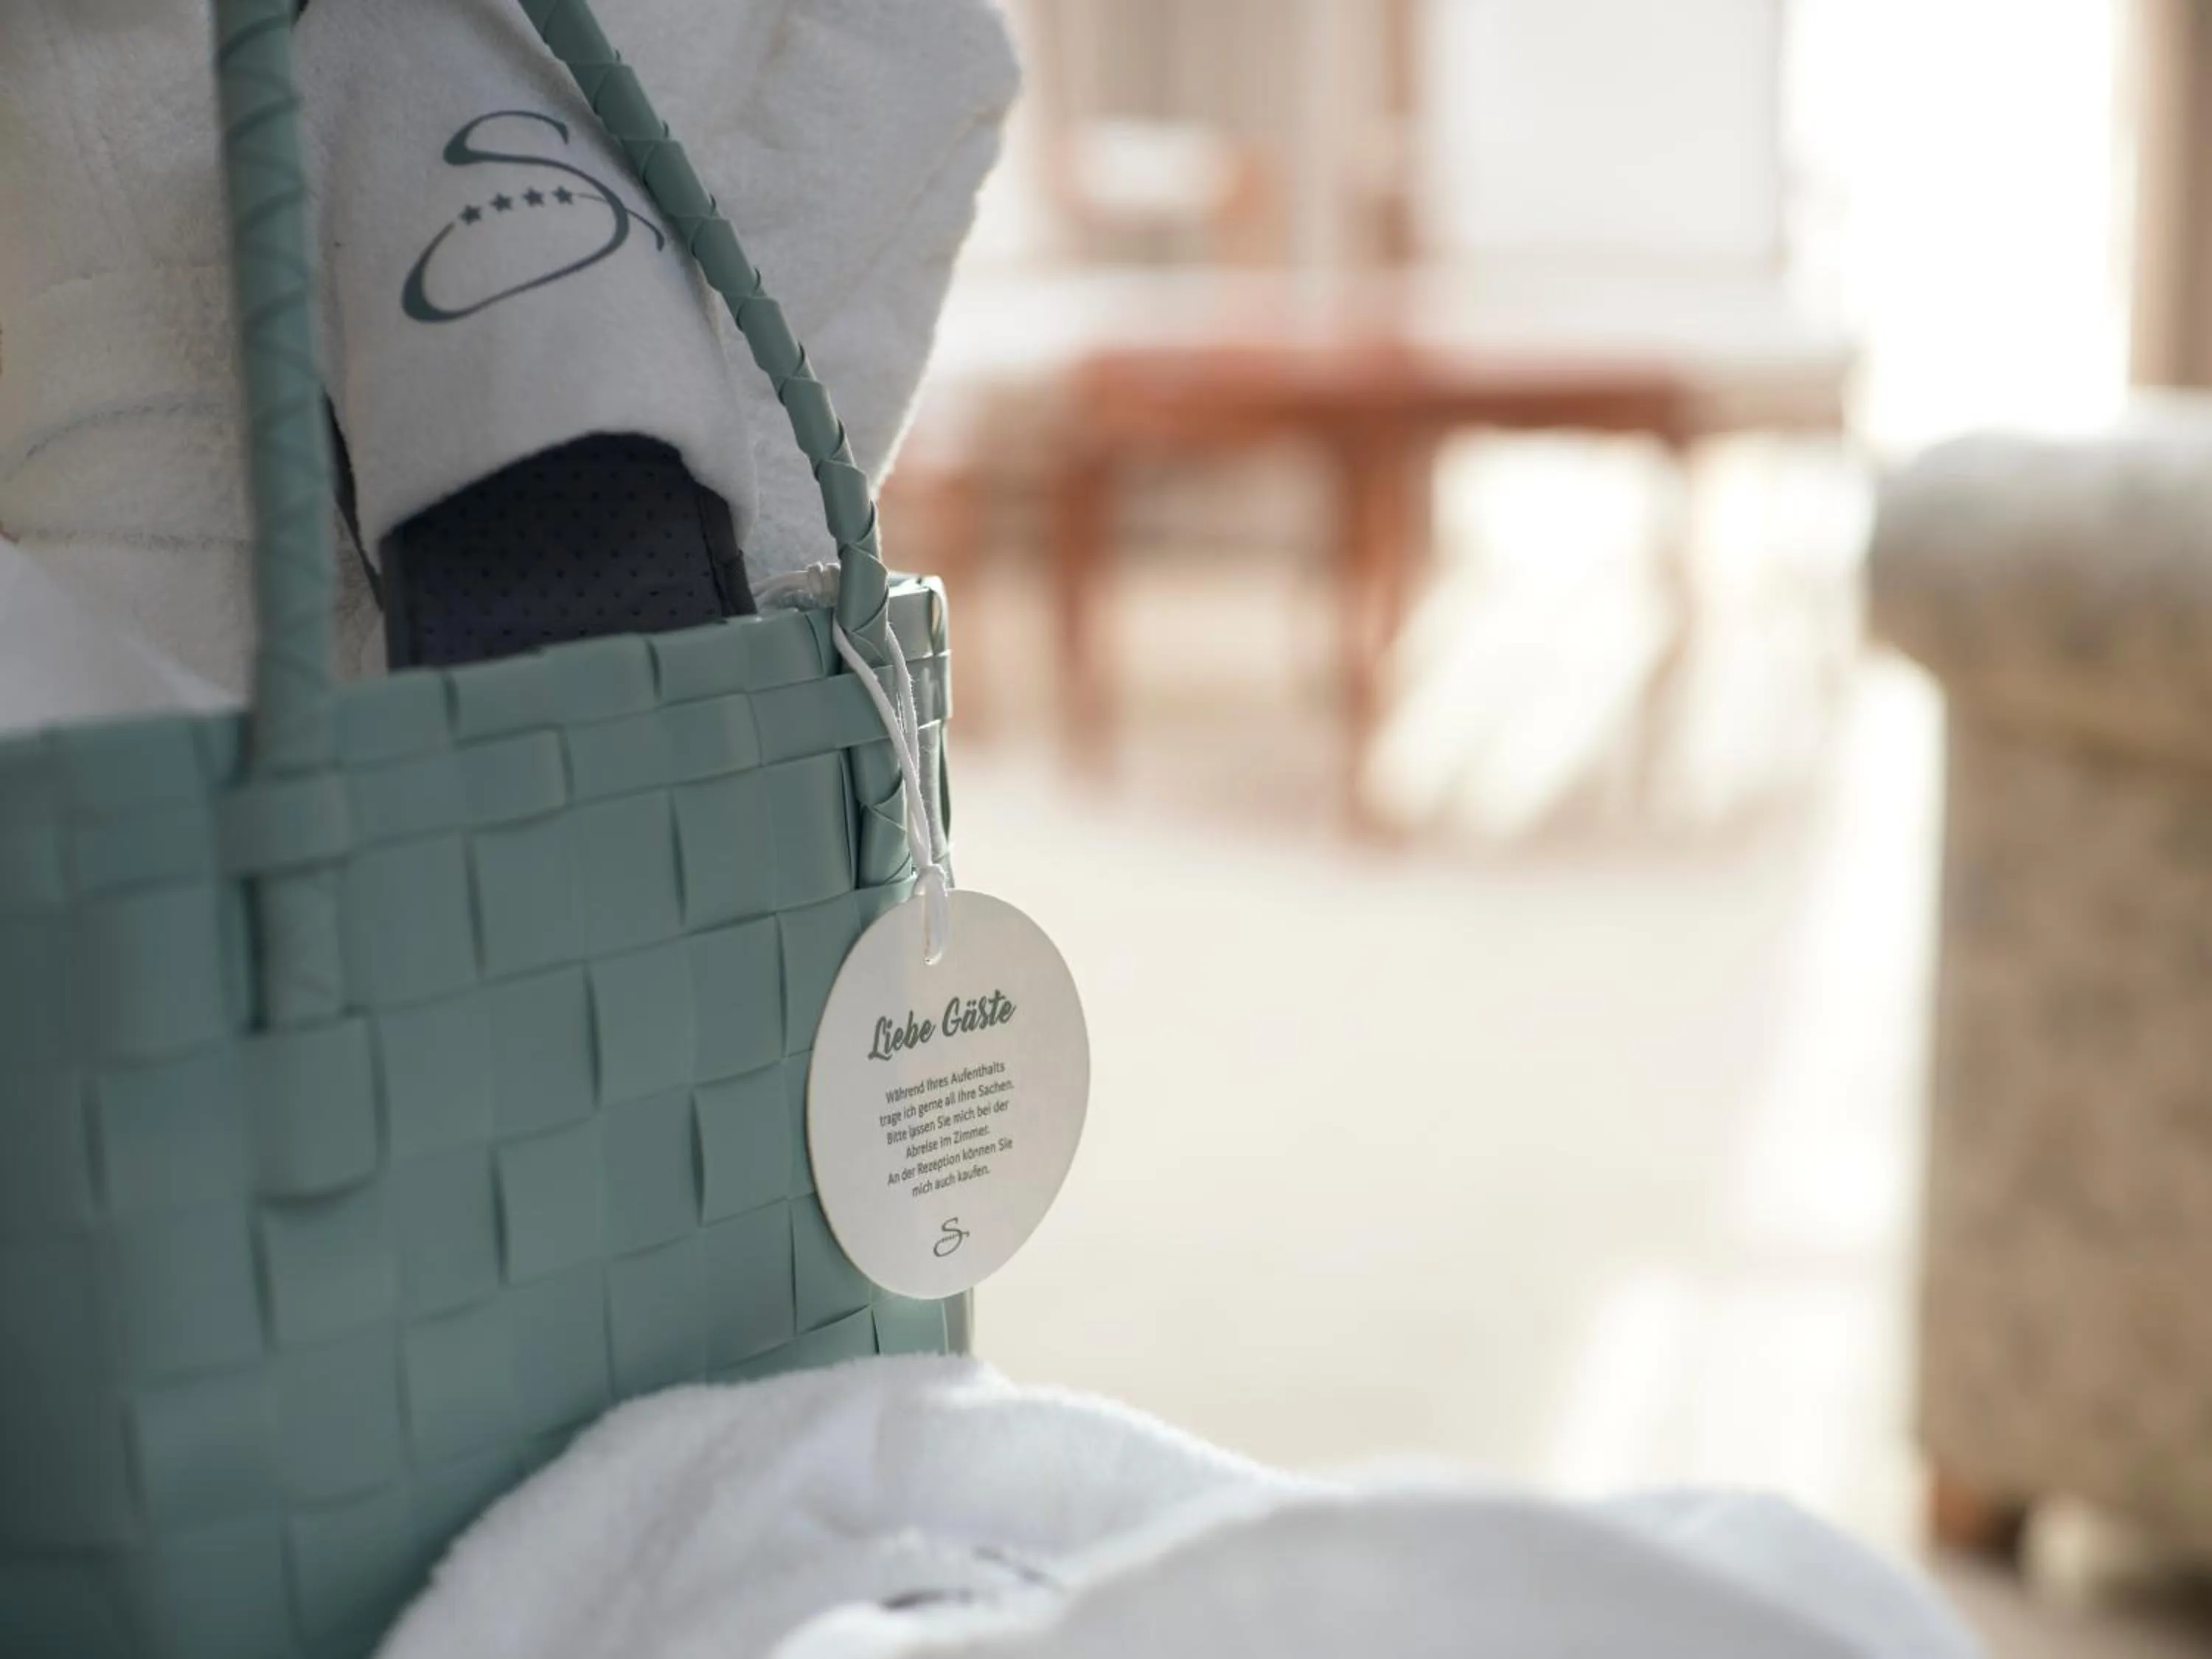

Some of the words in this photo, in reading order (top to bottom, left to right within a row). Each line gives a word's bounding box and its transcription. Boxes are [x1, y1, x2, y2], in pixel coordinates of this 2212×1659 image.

[868, 1010, 936, 1060] Liebe
[942, 990, 1017, 1037] Gäste
[880, 1111, 902, 1127] trage
[903, 1105, 917, 1119] ich
[918, 1099, 943, 1118] gerne
[945, 1092, 956, 1107] all
[958, 1089, 976, 1102] Ihre
[978, 1079, 1015, 1097] Sachen.
[886, 1081, 925, 1104] Während
[927, 1077, 948, 1092] Ihres
[950, 1062, 1006, 1085] Aufenthalts
[886, 1130, 908, 1145] Bitte
[908, 1121, 936, 1139] lassen
[937, 1114, 951, 1129] Sie
[953, 1107, 975, 1124] mich
[977, 1104, 992, 1118] bei
[993, 1099, 1009, 1113] der
[906, 1141, 939, 1158] Abreise
[940, 1135, 952, 1148] im
[953, 1124, 990, 1144] Zimmer.
[887, 1172, 900, 1186] An
[901, 1166, 916, 1180] der
[917, 1153, 961, 1175] Rezeption
[962, 1143, 995, 1161] können
[998, 1136, 1013, 1151] Sie
[912, 1180, 933, 1197] mich
[935, 1174, 956, 1189] auch
[958, 1164, 990, 1181] kaufen.
